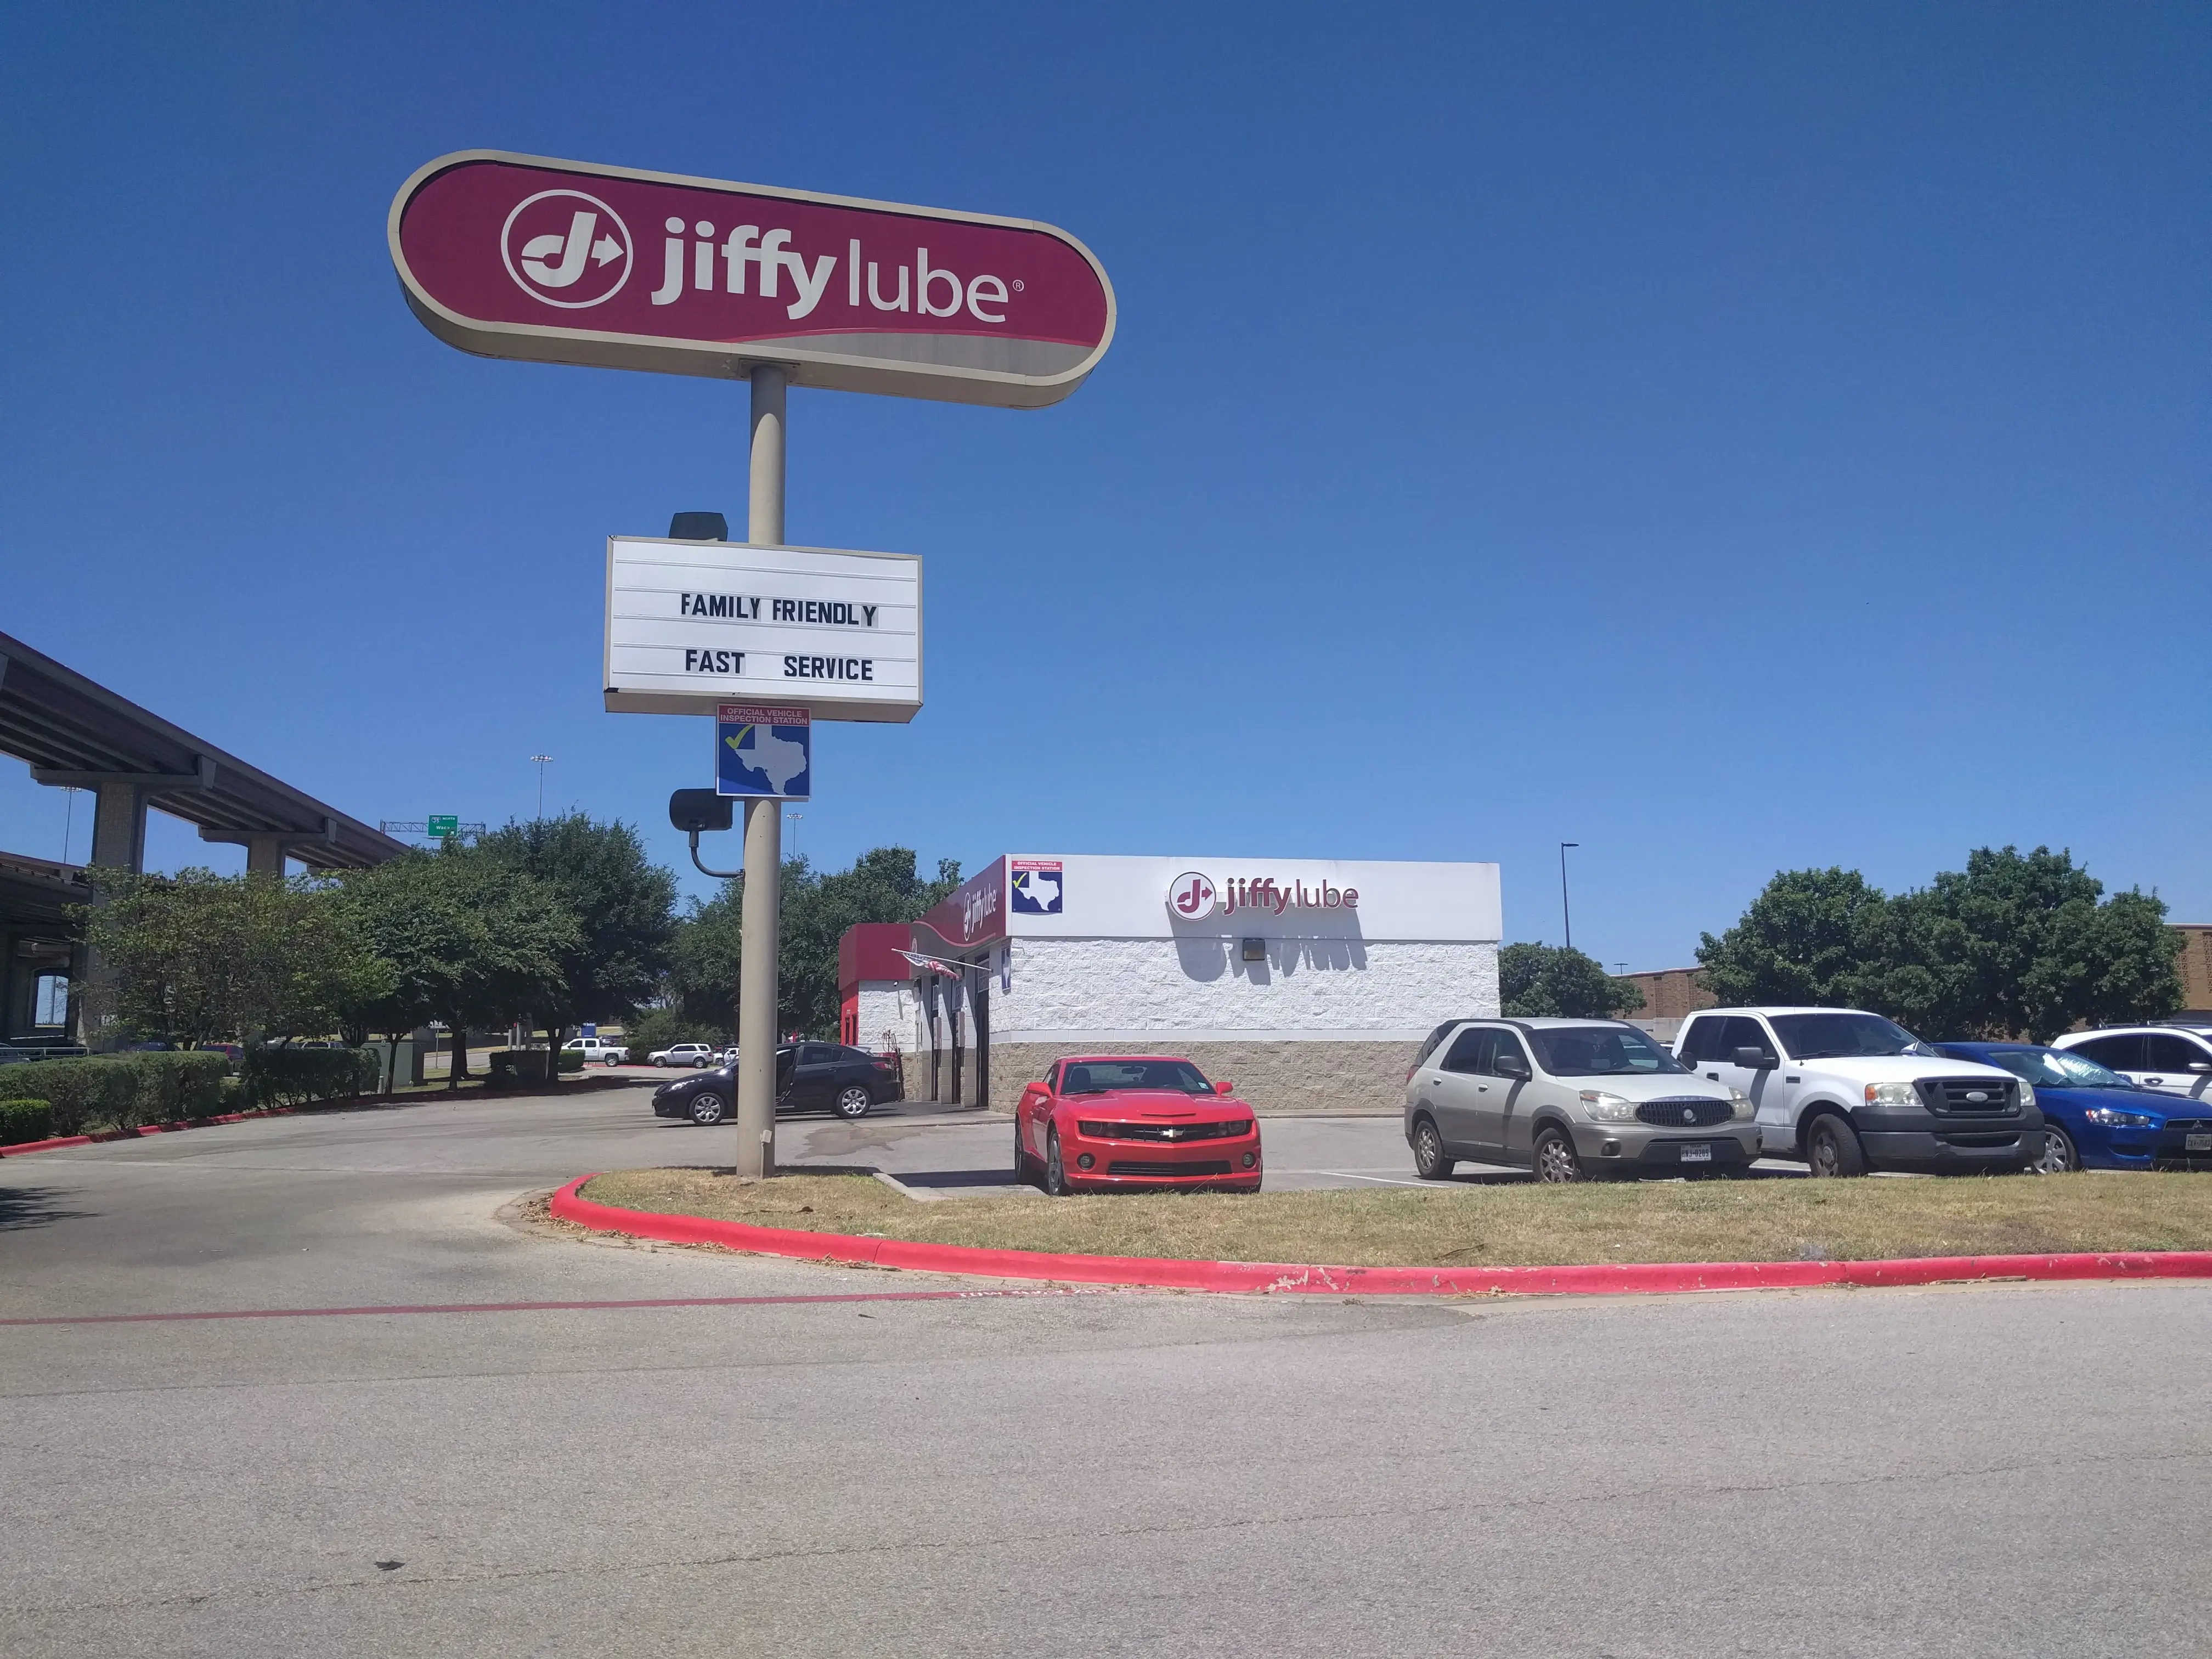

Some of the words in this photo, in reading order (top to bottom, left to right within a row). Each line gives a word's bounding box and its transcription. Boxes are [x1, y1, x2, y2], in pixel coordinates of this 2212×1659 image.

[681, 593, 760, 619] FAMILY
[772, 599, 877, 627] FRIENDLY
[686, 649, 745, 674] FAST
[784, 656, 873, 680] SERVICE
[720, 714, 771, 723] INSPECTION
[773, 716, 808, 725] STATION
[727, 708, 765, 716] OFFICIAL
[766, 709, 803, 718] VEHICLE
